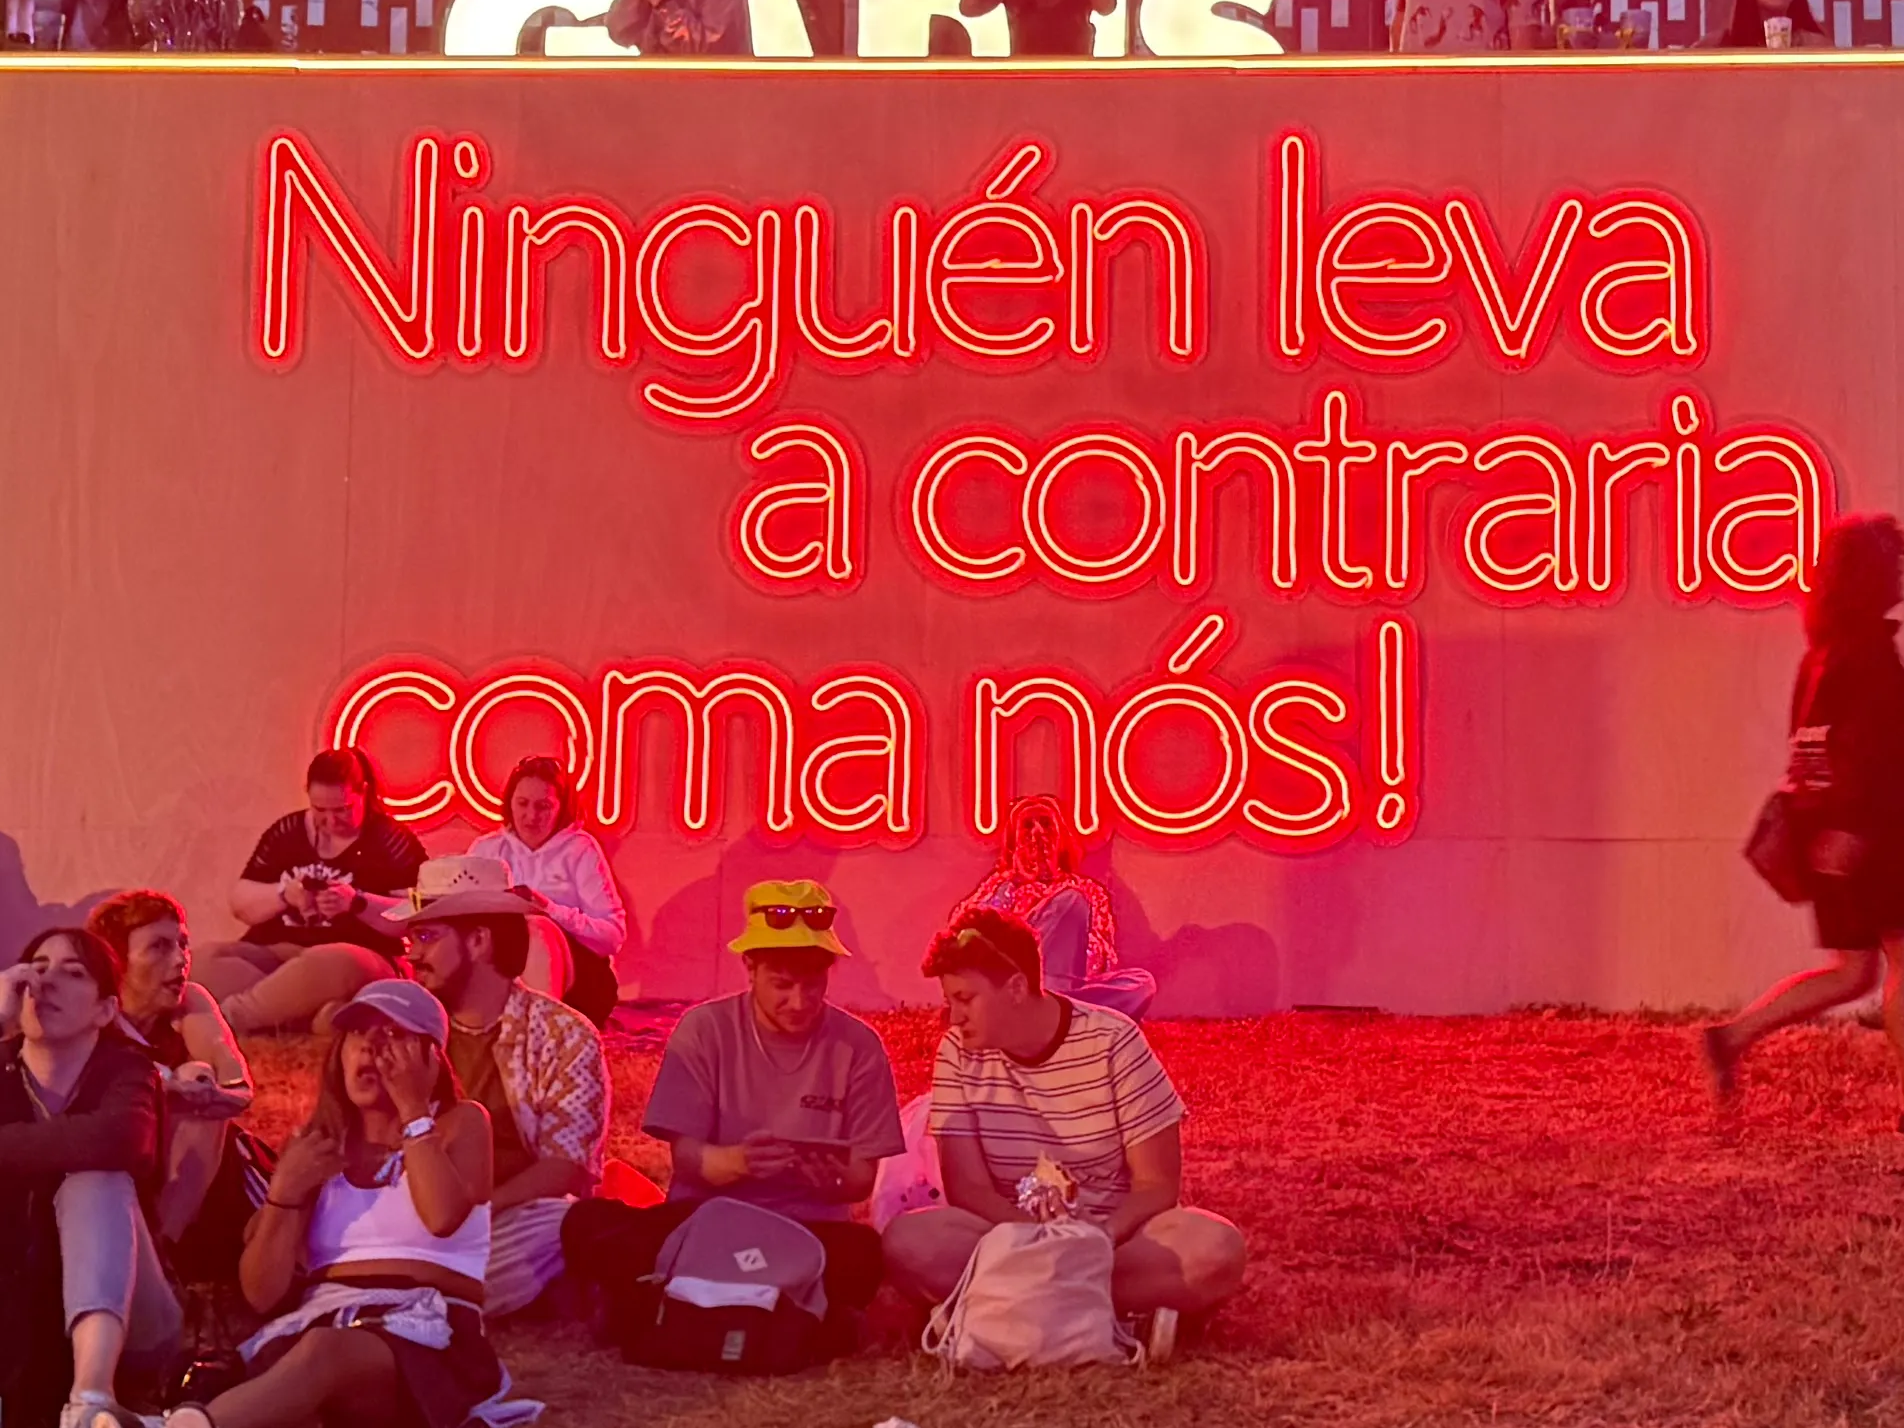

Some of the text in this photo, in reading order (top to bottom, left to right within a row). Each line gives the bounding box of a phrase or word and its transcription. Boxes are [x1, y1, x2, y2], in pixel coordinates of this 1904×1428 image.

[264, 135, 1696, 419] Ninguén leva
[740, 391, 1820, 592] a contraria
[333, 614, 1407, 836] coma nós!
